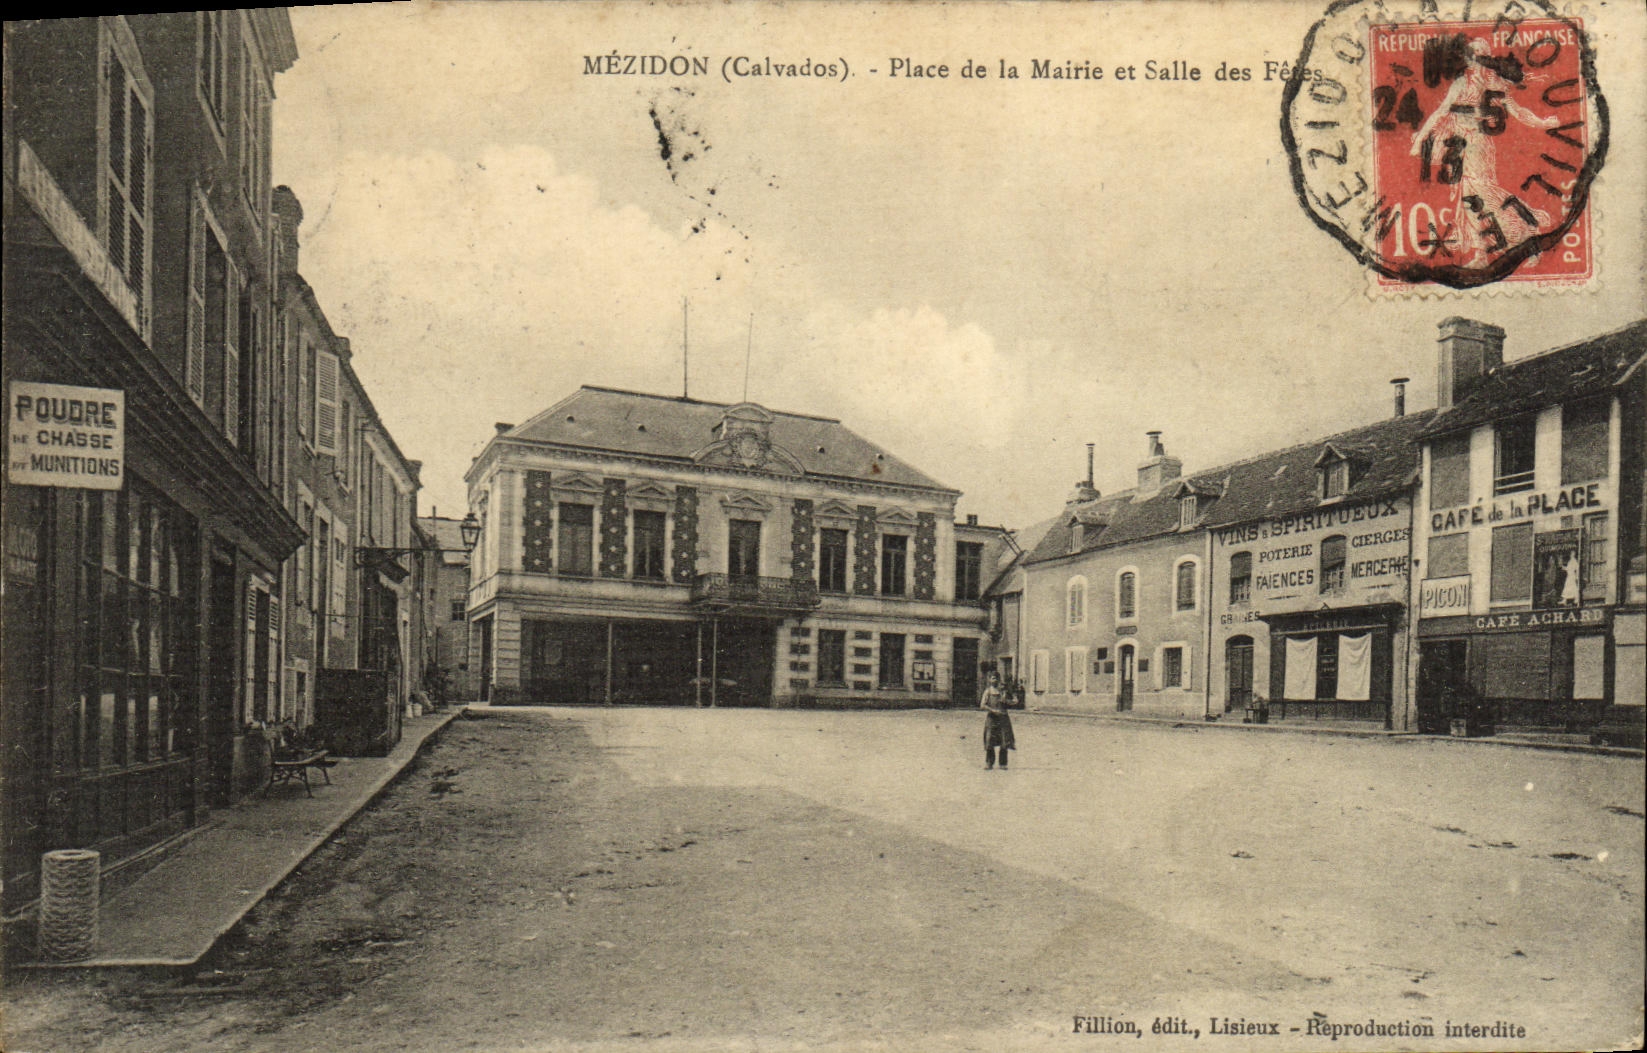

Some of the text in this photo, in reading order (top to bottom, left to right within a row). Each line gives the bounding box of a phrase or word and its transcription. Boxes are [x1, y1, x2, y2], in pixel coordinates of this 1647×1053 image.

[1560, 178, 1582, 264] POTES
[15, 395, 117, 429] POUDRE
[37, 430, 113, 450] CHASSE
[30, 453, 119, 477] MUNITIONS
[1431, 483, 1600, 532] CAFÉ de la PLACE
[1217, 525, 1259, 547] VINS
[1271, 500, 1399, 537] SPIRITUEUX
[1351, 527, 1411, 548] CIERGES
[1258, 544, 1313, 563] POTERIE
[1351, 555, 1409, 578] MERCERIE
[1424, 583, 1469, 610] PICON
[1220, 611, 1260, 625] GRES
[1527, 608, 1604, 626] ACHARD
